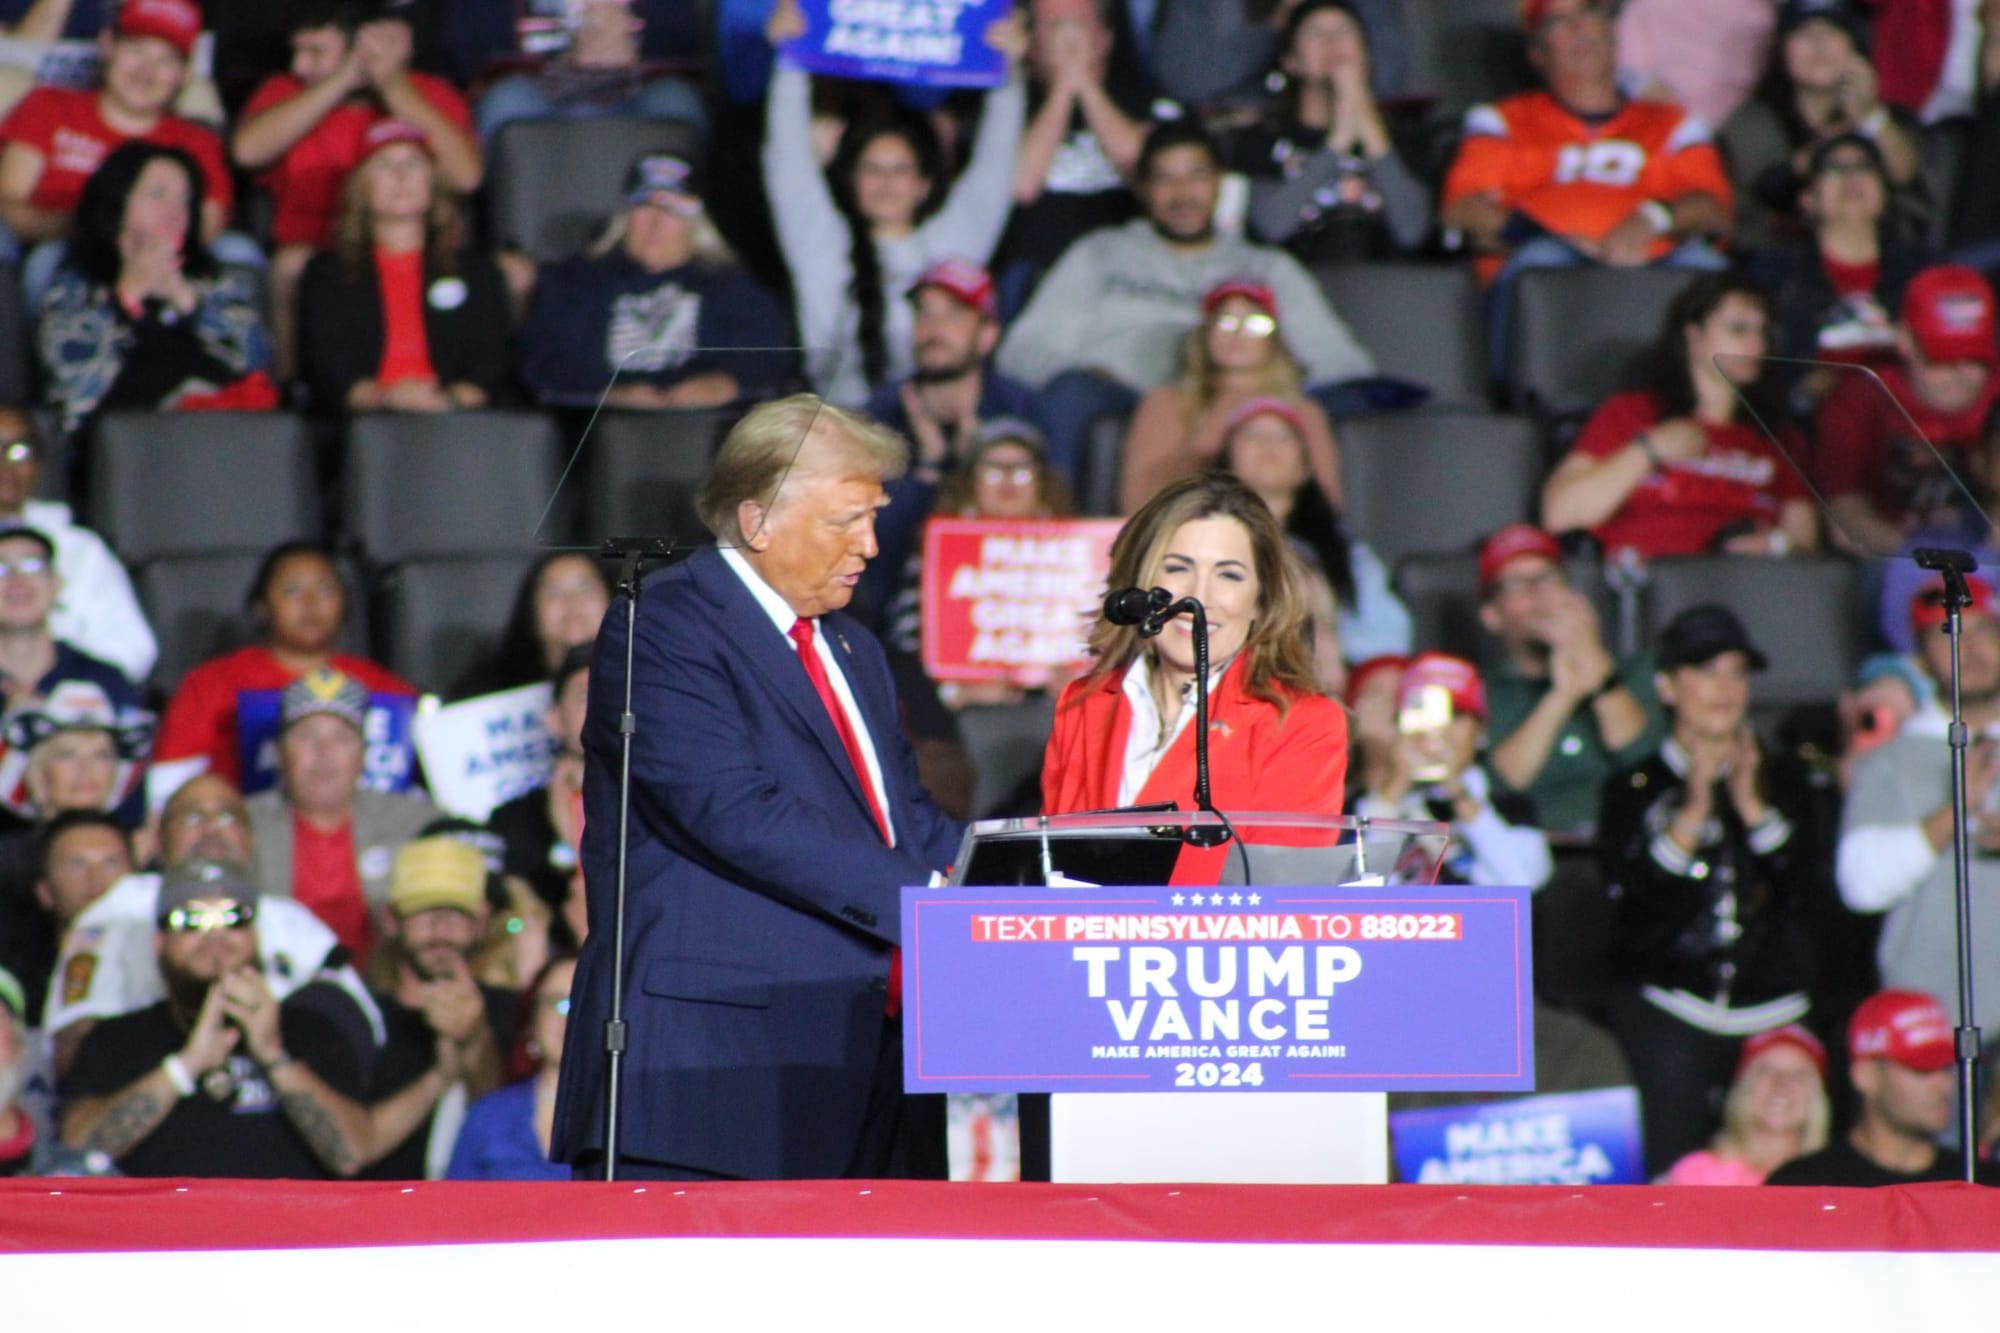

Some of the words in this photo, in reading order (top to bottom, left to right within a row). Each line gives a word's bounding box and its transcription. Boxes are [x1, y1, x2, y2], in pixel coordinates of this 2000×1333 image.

[982, 536, 1093, 569] MAKE
[978, 916, 1057, 940] TEXT
[1065, 915, 1303, 940] PENNSYLVANIA
[1310, 915, 1352, 939] TO
[1360, 915, 1456, 939] 88022
[1073, 946, 1362, 998] TRUMP
[1106, 998, 1330, 1041] VANCE
[1092, 1045, 1140, 1059] MAKE
[1145, 1045, 1222, 1059] AMERICA
[1226, 1045, 1282, 1058] GREAT
[1286, 1045, 1346, 1058] AGAIN!
[1175, 1062, 1265, 1087] 2024
[1446, 1114, 1570, 1154] MAKE
[1417, 1143, 1615, 1185] AMERICA
